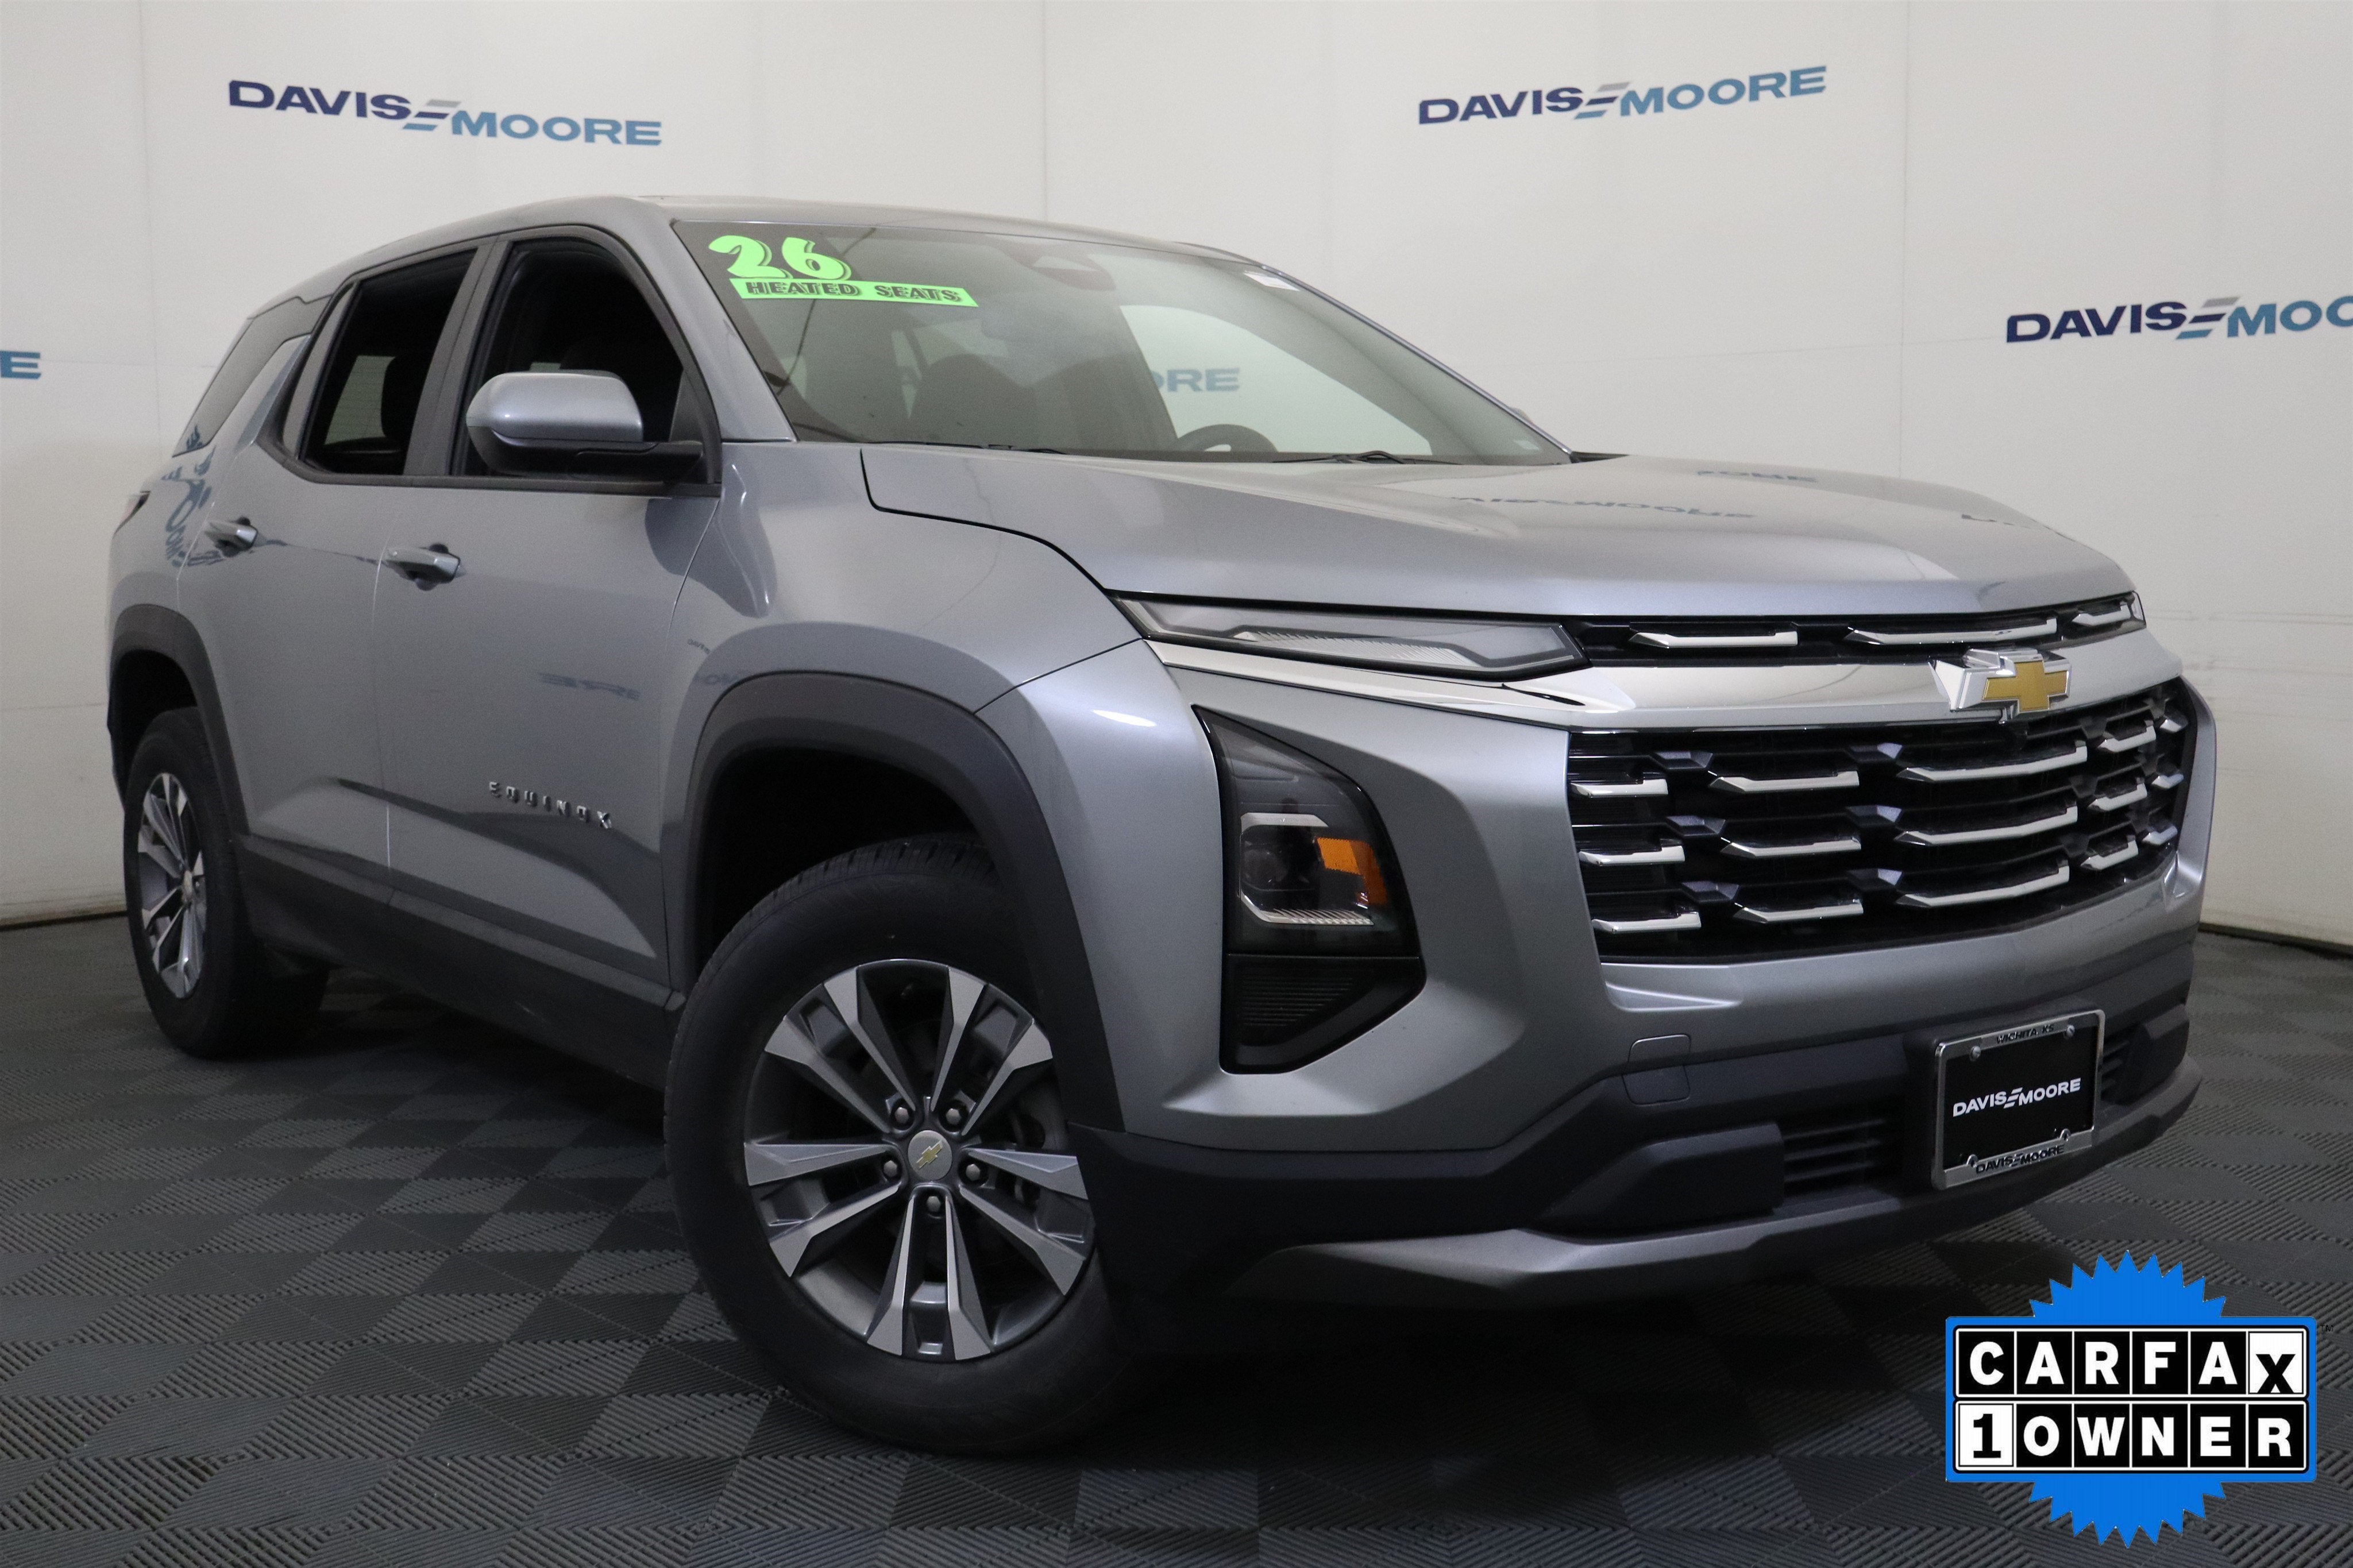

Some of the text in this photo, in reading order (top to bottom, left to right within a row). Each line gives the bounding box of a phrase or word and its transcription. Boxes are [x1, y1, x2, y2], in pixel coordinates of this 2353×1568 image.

[229, 79, 662, 146] DAVIS MOORE
[1418, 65, 1827, 125] DAVIS MOORE
[708, 235, 851, 280] 26
[746, 281, 963, 302] HEATED SEATS
[2006, 301, 2188, 343] DAVIS
[489, 781, 612, 829] EQUINOX
[1953, 1078, 2081, 1117] DAVIS MOORE
[1976, 1145, 2065, 1173] DAVIS MOORE
